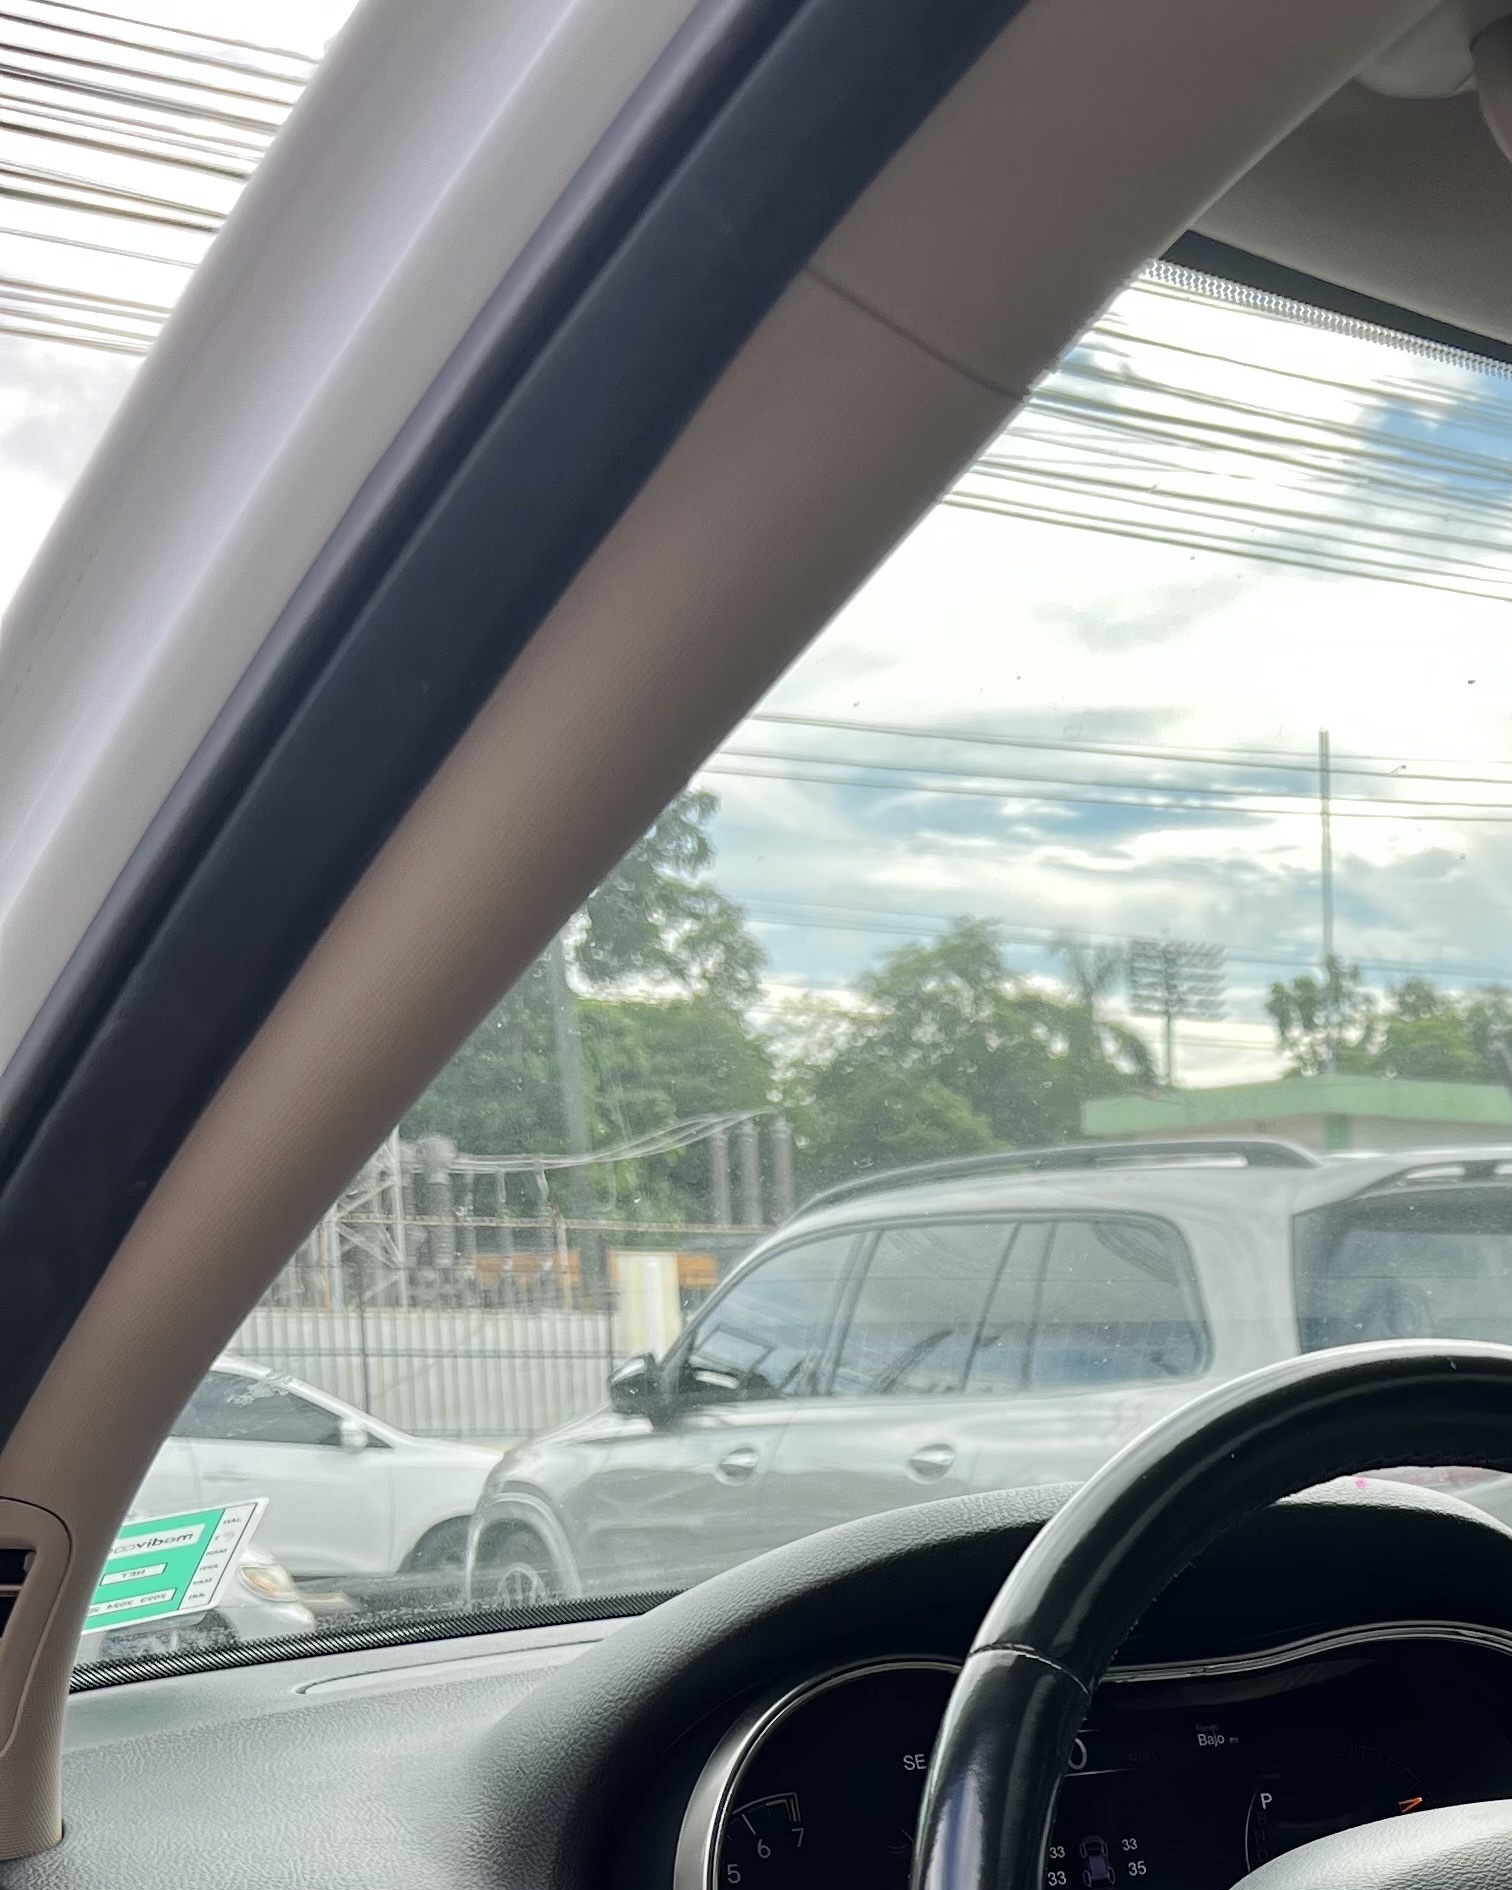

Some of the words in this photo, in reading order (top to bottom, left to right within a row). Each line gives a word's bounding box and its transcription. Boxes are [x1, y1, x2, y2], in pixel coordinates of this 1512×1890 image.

[1197, 1732, 1225, 1748] Bajo
[903, 1753, 927, 1771] SE
[1260, 1791, 1274, 1809] P
[792, 1827, 805, 1848] 7
[1121, 1837, 1138, 1852] 33
[756, 1838, 772, 1859] 6
[1049, 1845, 1066, 1860] 33
[726, 1863, 742, 1884] 5
[1127, 1860, 1148, 1877] 35
[1047, 1871, 1067, 1887] 33
